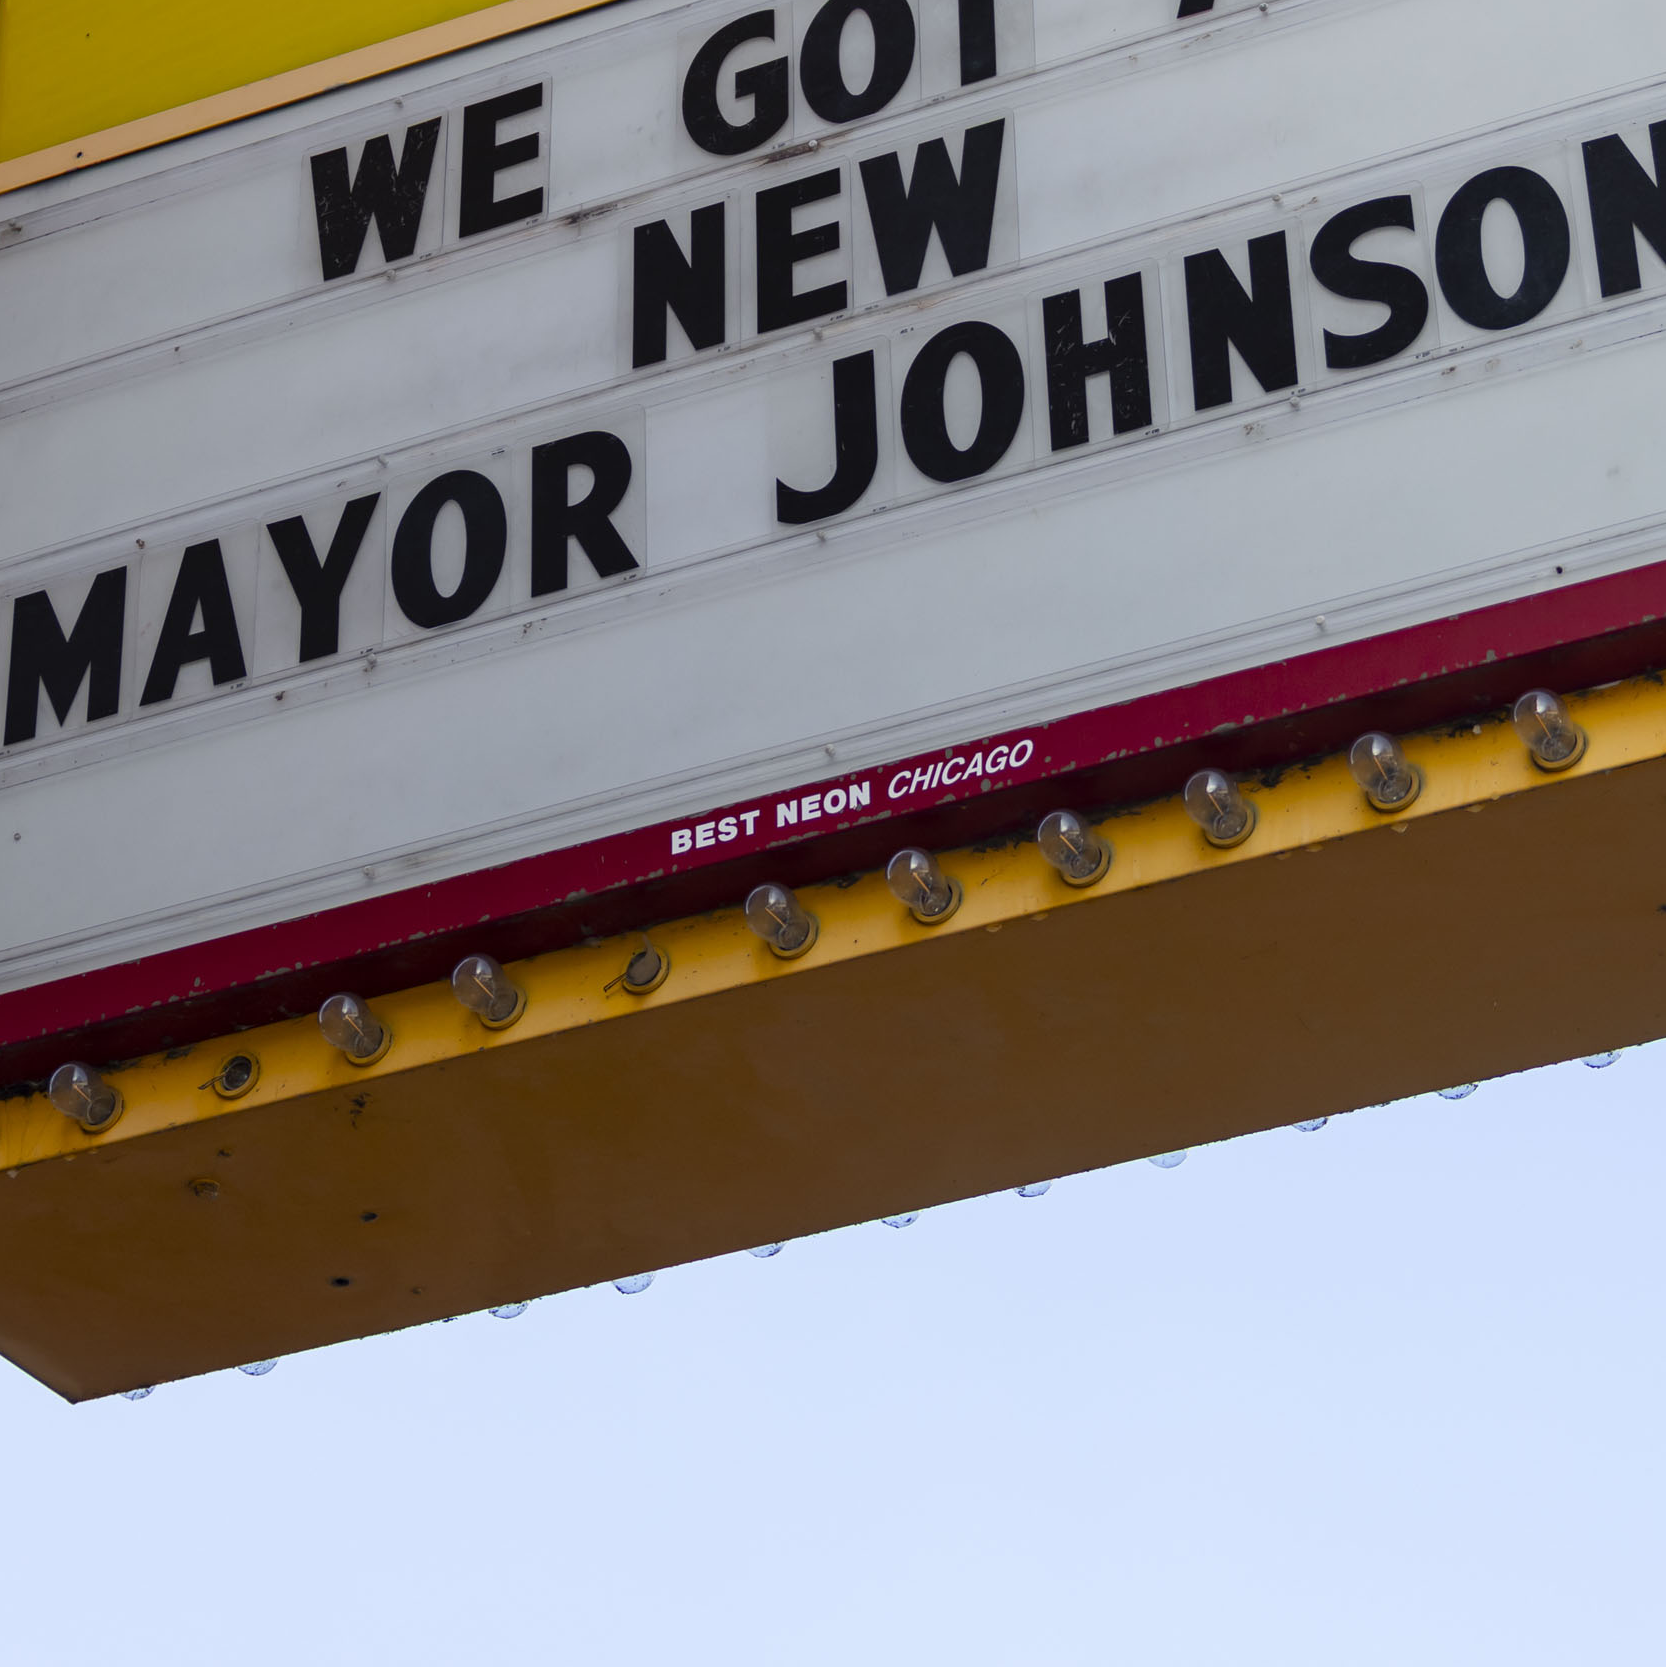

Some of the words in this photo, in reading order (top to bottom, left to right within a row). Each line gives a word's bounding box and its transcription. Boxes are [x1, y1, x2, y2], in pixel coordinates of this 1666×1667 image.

[309, 82, 544, 282] WE
[632, 117, 1006, 369] NEW
[3, 430, 640, 747] MAYOR
[671, 809, 761, 855] BEST
[776, 780, 871, 828] NEON
[887, 739, 1034, 799] CHICAGO
